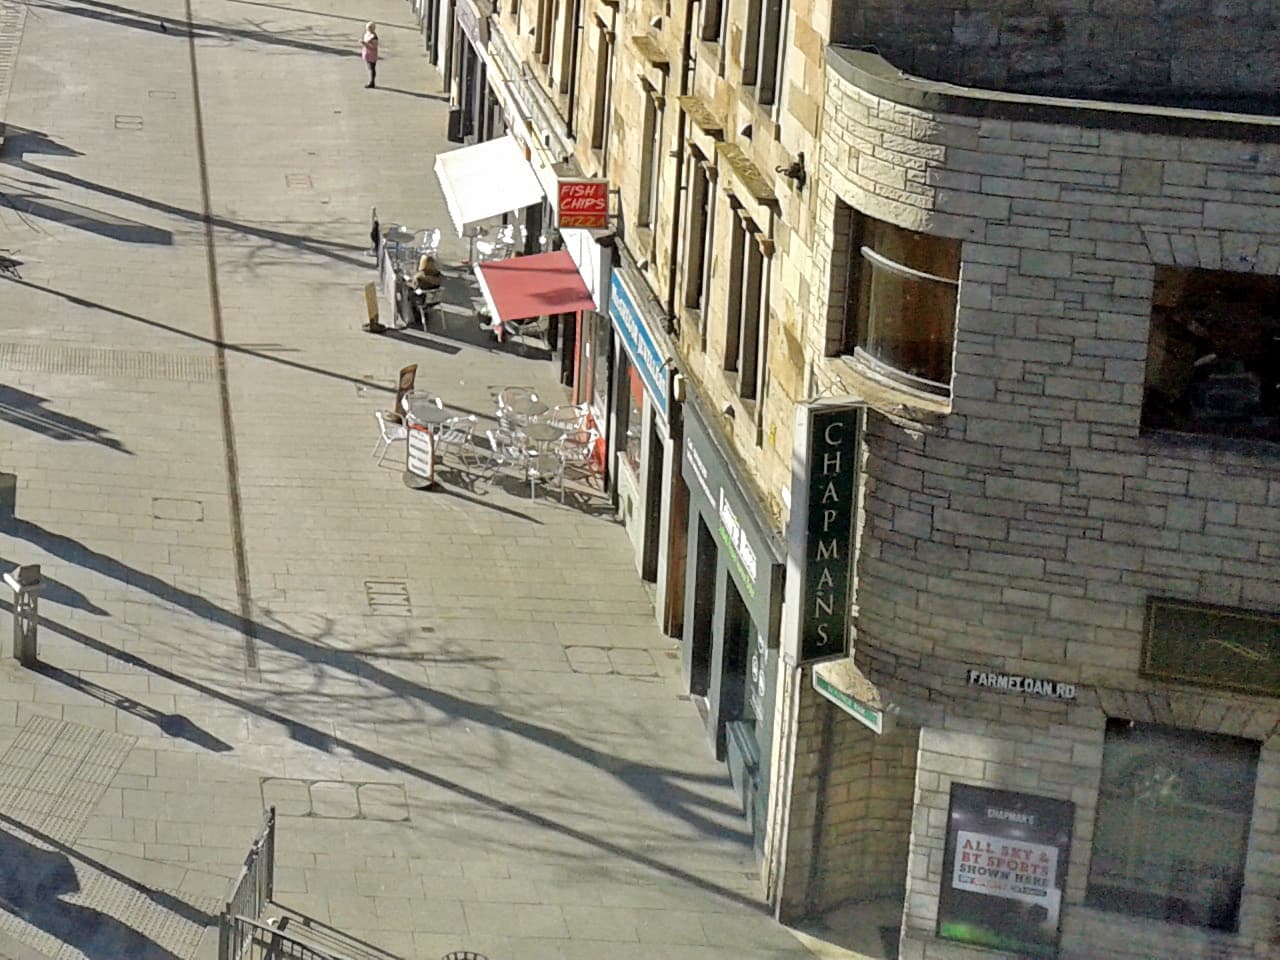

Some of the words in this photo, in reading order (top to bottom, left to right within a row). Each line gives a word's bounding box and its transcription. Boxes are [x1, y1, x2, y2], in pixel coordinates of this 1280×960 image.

[561, 185, 596, 197] FISH
[561, 198, 606, 210] CHIPS
[814, 422, 844, 647] CHAPMANS
[970, 669, 1053, 695] FARMELOAN
[962, 839, 994, 854] ALL
[1001, 845, 1034, 861] SKY
[960, 863, 1011, 880] SHOWN
[1015, 872, 1050, 888] HERE
[962, 851, 982, 865] BT
[986, 856, 1050, 877] SPORTS
